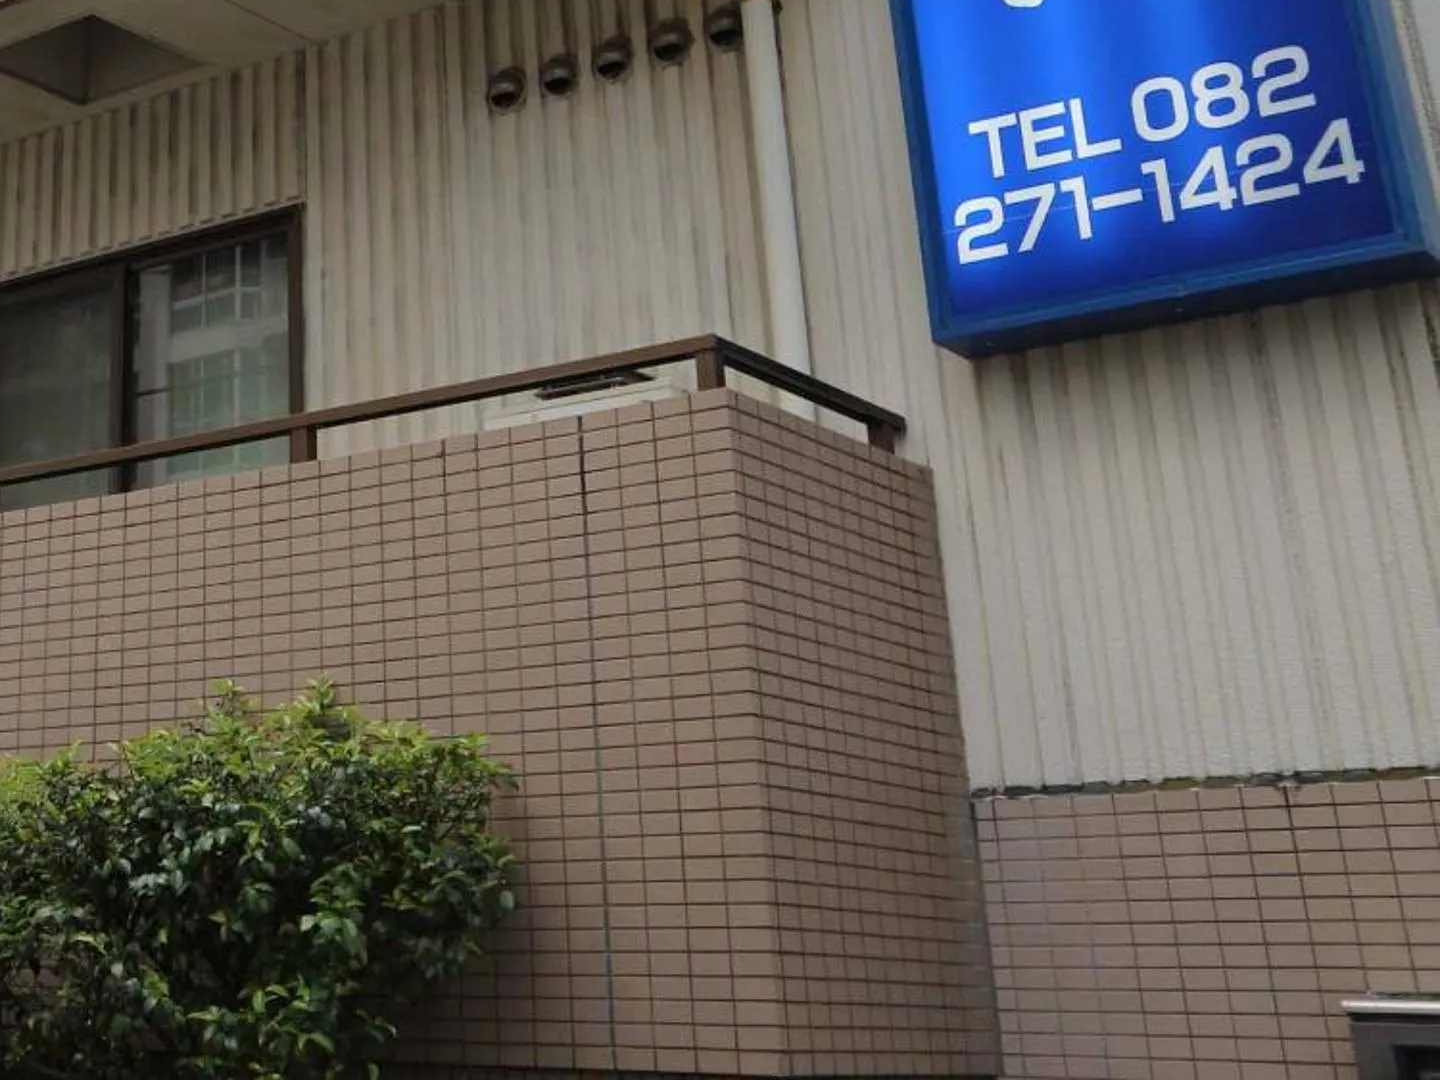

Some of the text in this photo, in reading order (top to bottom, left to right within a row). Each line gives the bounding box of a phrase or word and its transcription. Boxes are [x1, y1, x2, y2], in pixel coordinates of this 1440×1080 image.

[968, 45, 1317, 178] TEL 082
[954, 118, 1365, 264] 271-1424
